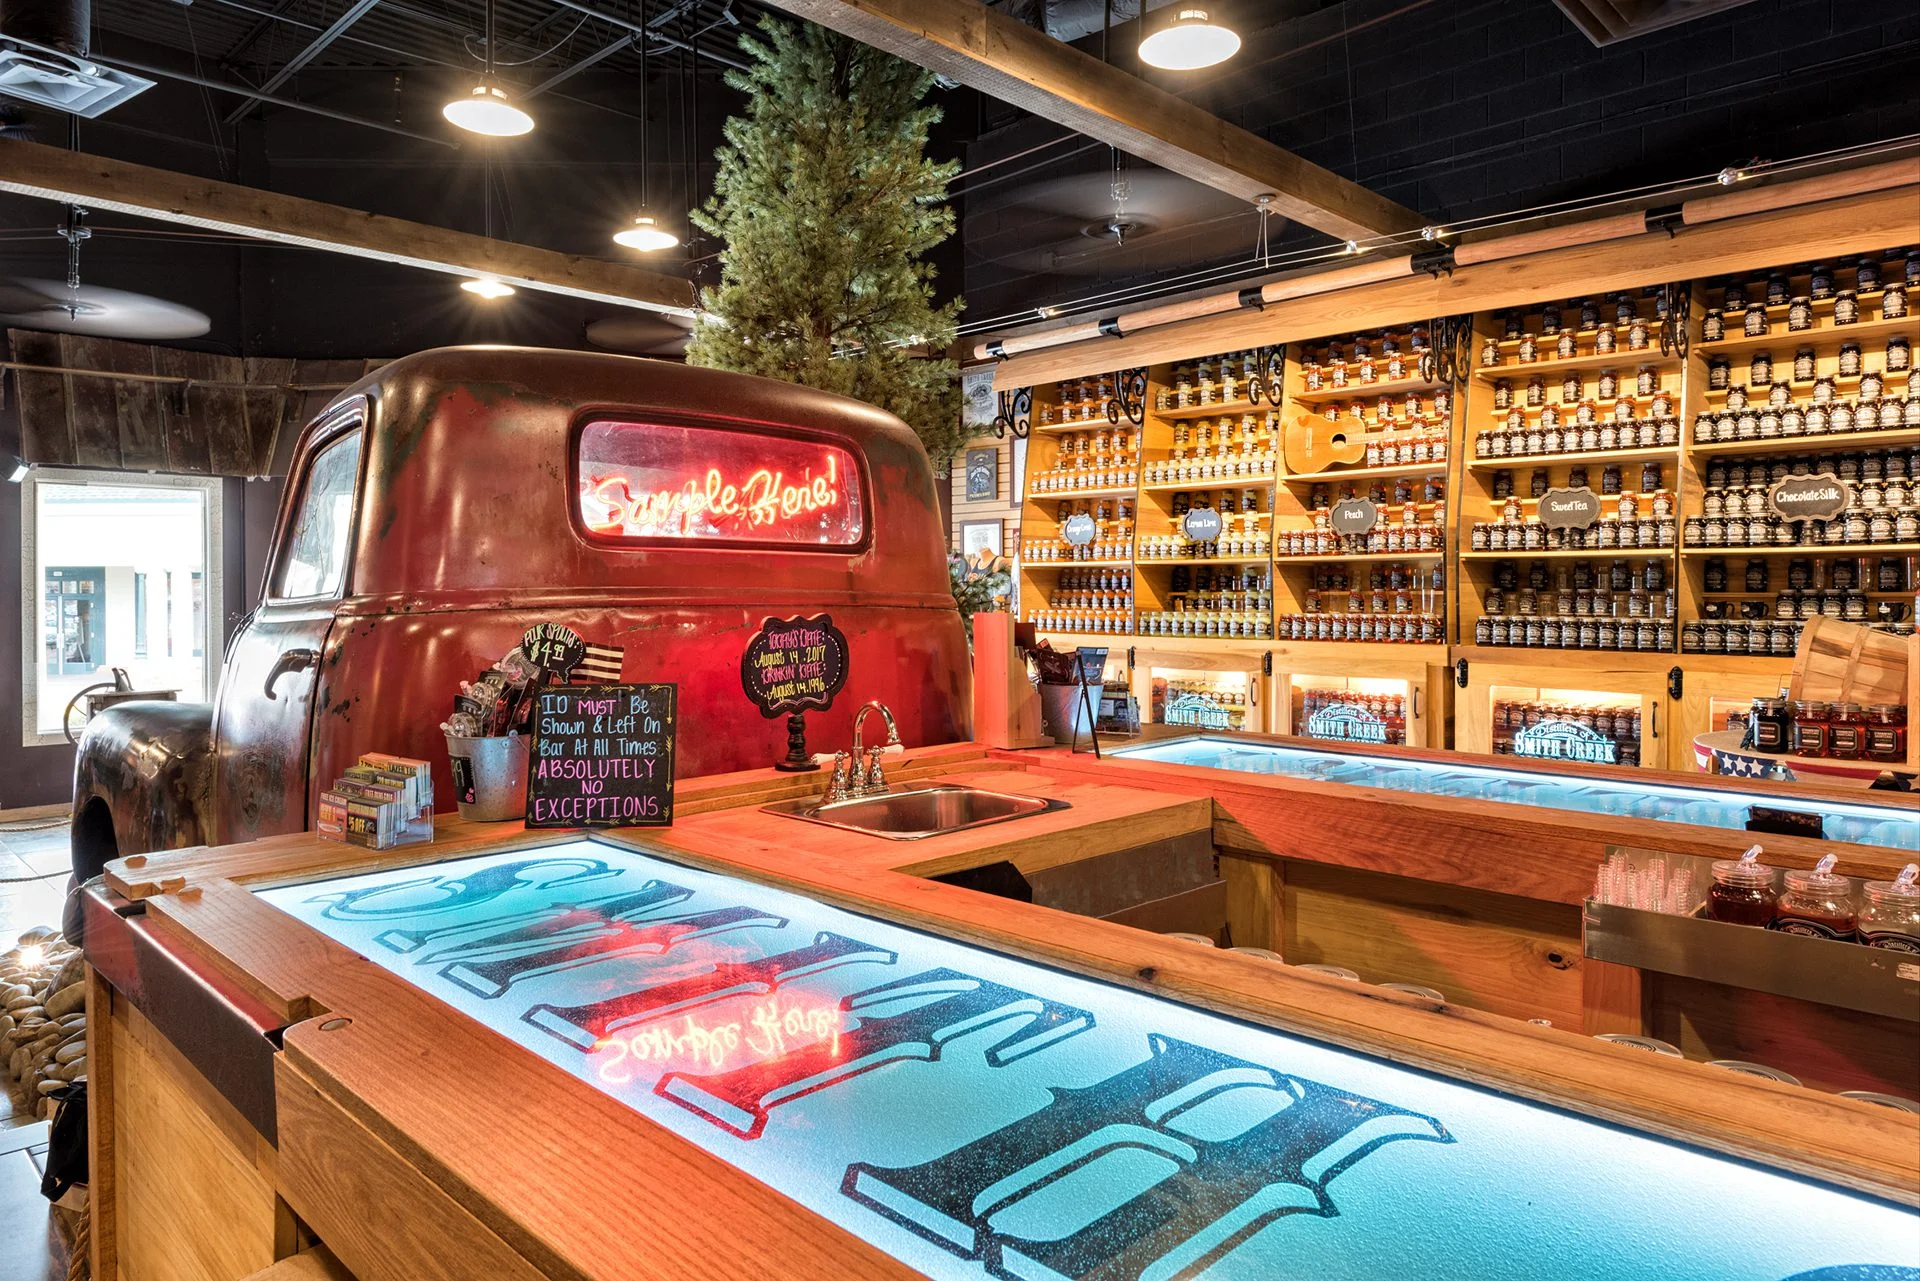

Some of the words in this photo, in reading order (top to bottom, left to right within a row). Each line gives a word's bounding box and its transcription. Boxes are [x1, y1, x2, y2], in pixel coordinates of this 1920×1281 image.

[591, 469, 739, 536] Sample
[742, 455, 837, 525] Here!
[1344, 509, 1364, 520] Peach
[524, 624, 545, 647] POUR
[754, 650, 785, 671] August
[767, 680, 795, 703] August
[541, 695, 568, 715] ID
[578, 699, 616, 715] MUST
[630, 695, 649, 715] Be
[1165, 703, 1196, 724] SMITH
[1199, 707, 1230, 728] CREEK
[541, 718, 584, 735] Shown
[593, 715, 603, 732] &
[608, 715, 636, 734] Left
[644, 719, 661, 734] On
[1308, 712, 1345, 736] SMITH
[1347, 719, 1387, 741] CREEK
[1536, 723, 1578, 736] Distillers
[540, 739, 564, 757] Bar
[574, 739, 588, 755] At
[594, 739, 609, 756] All
[616, 739, 657, 756] Times
[1515, 730, 1561, 757] SMITH
[1565, 736, 1616, 763] CREEK
[538, 759, 656, 779] ABSOLUTELY
[582, 780, 604, 795] NO
[535, 796, 659, 821] EXCEPTIONS
